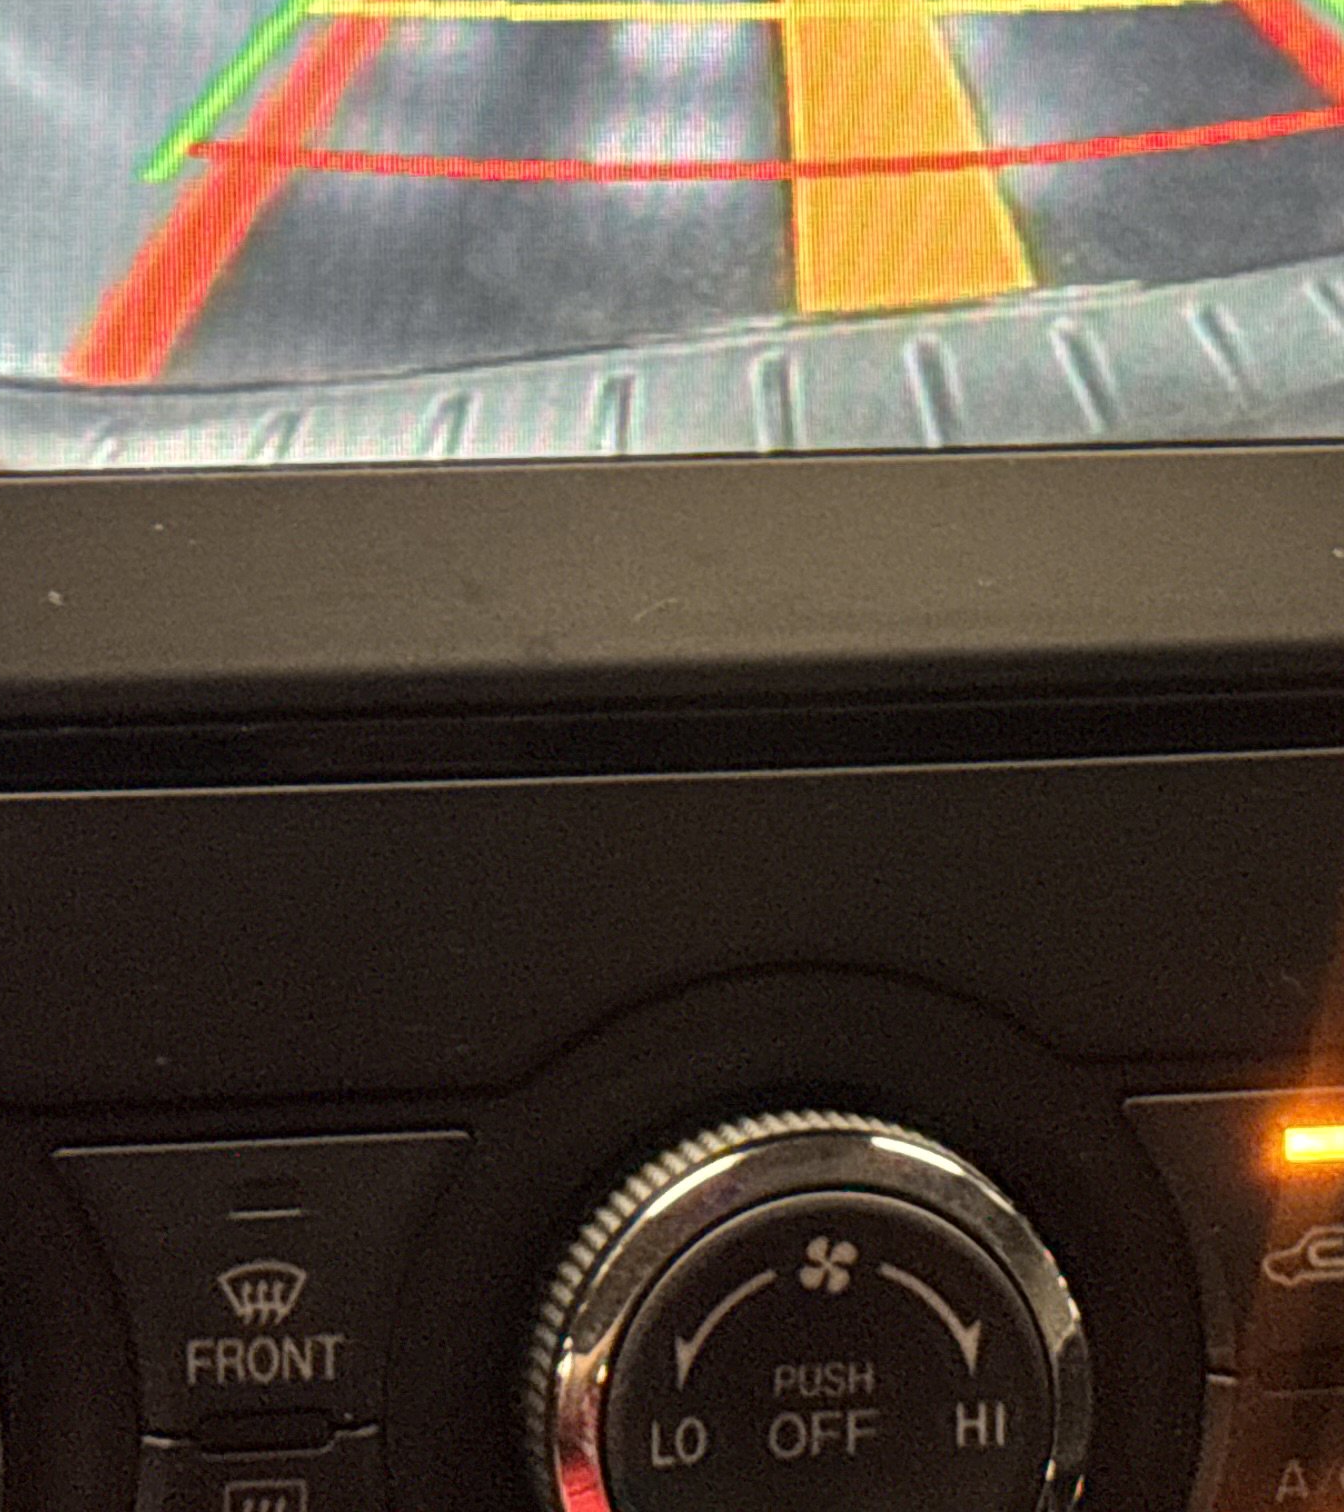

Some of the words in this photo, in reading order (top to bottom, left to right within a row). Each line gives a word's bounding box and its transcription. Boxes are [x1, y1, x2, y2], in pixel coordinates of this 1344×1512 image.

[185, 1333, 346, 1386] FRONT
[772, 1361, 875, 1400] PUSH
[649, 1419, 709, 1468] LO
[766, 1409, 878, 1460] OFF
[956, 1402, 1006, 1449] HI
